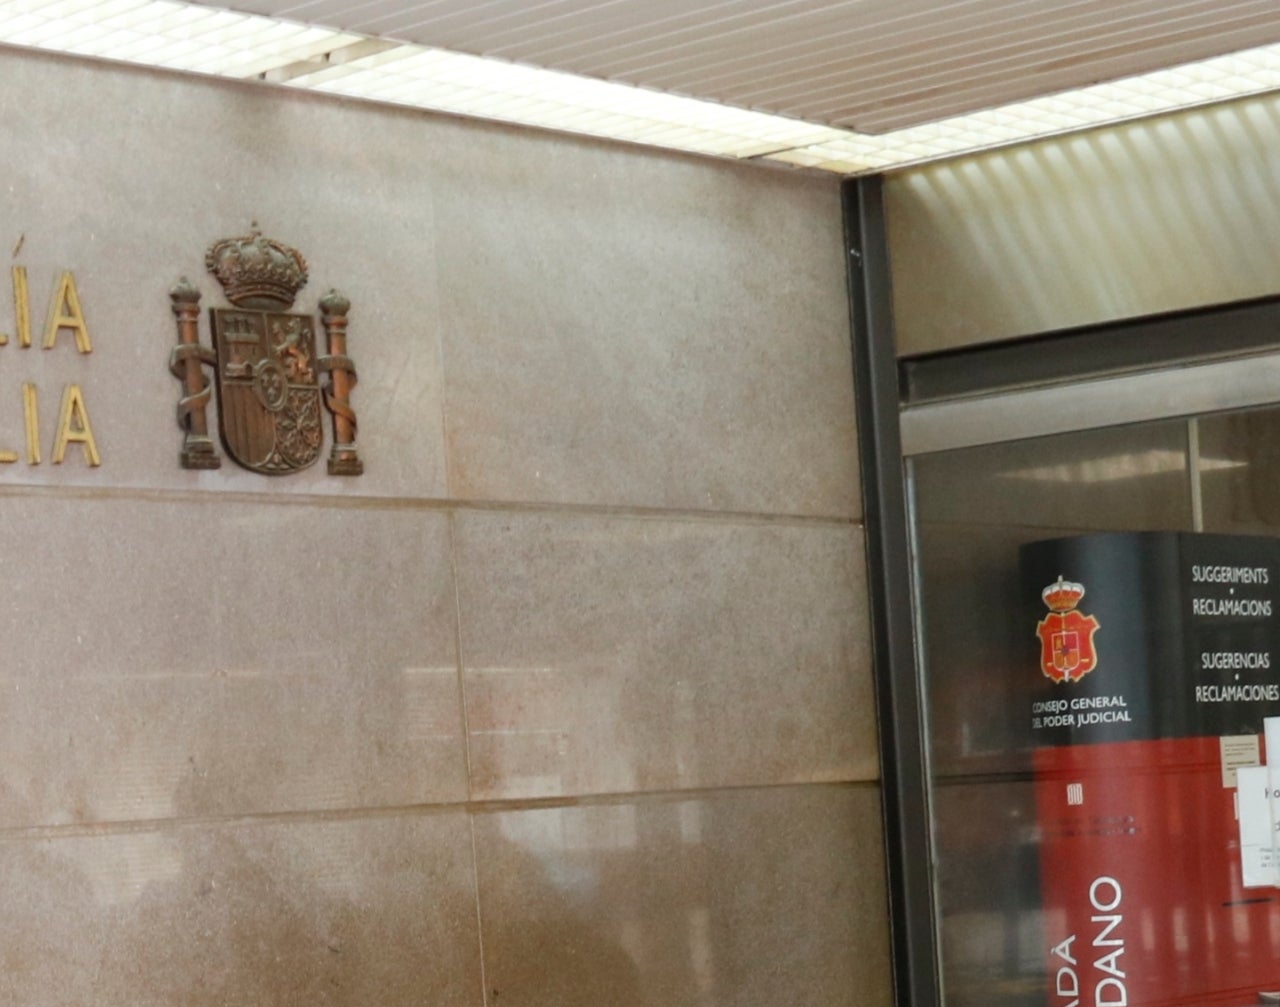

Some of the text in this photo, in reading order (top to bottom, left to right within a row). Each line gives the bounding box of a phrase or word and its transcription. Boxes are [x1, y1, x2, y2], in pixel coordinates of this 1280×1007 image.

[1192, 565, 1269, 584] SUGGERIMENTS
[1192, 599, 1272, 616] RECLAMACIONS
[1201, 652, 1270, 669] SUGERENCIAS
[1195, 684, 1279, 702] RECLAMACIONES
[1032, 696, 1127, 714] CONSEJO GENERAL
[1043, 714, 1075, 728] PODER
[1077, 710, 1132, 728] JUDICIAL
